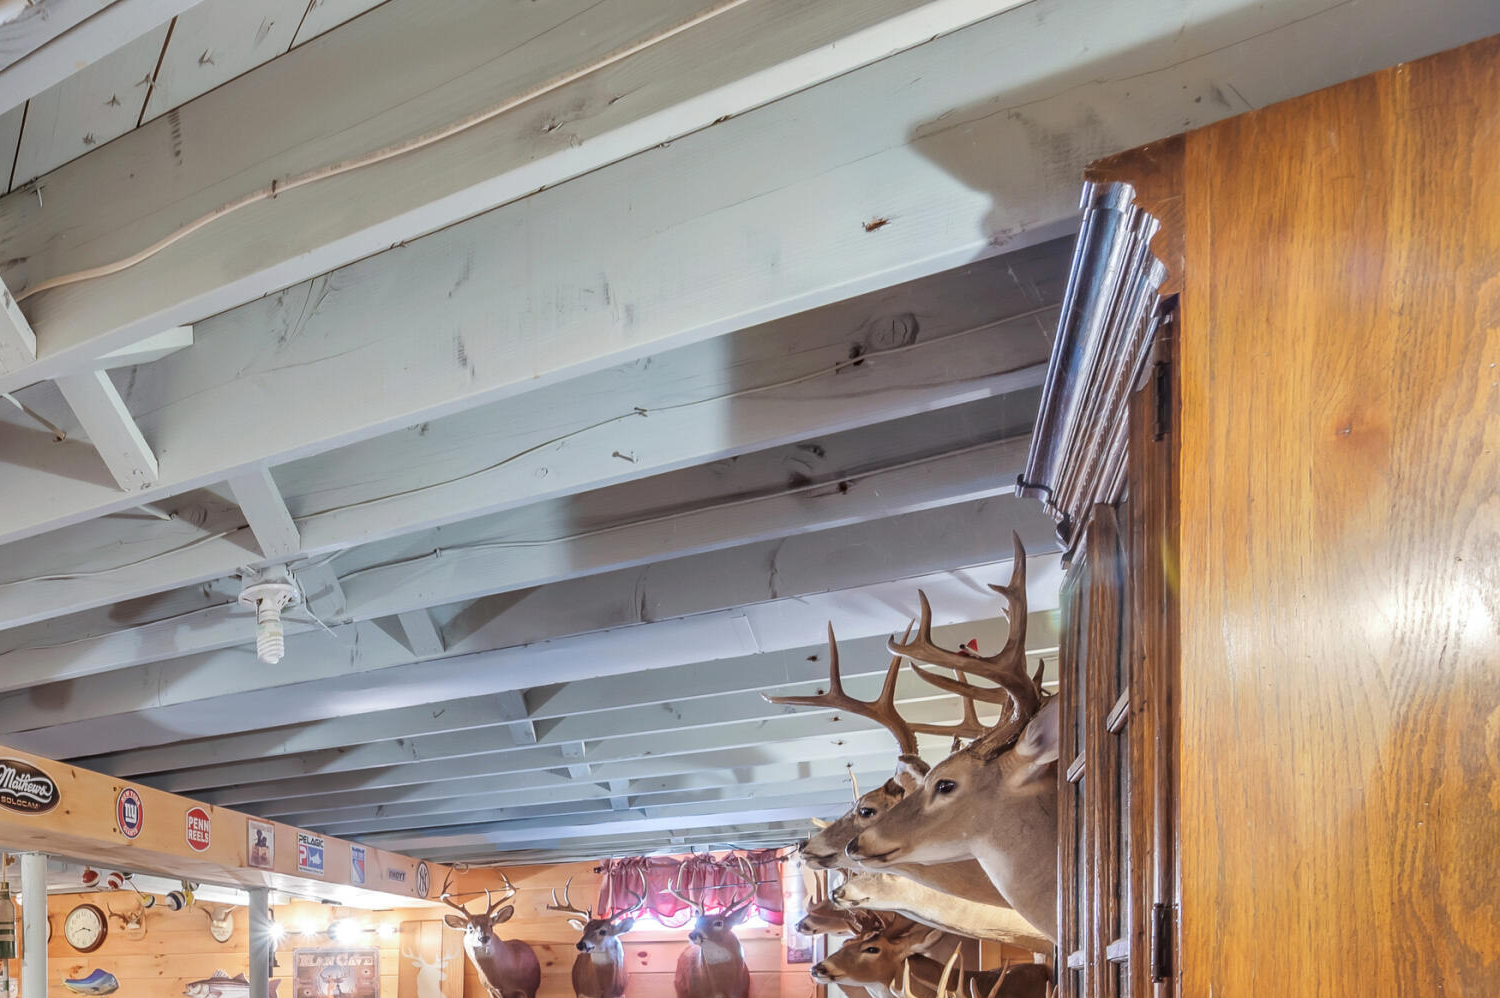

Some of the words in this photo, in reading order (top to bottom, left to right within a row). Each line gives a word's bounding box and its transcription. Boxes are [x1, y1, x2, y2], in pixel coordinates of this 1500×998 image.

[1, 796, 39, 809] SOLOCAM
[188, 816, 209, 832] PENN
[188, 830, 209, 843] REELS
[298, 834, 324, 848] PELAGIC
[299, 954, 335, 967] MAN
[336, 953, 374, 966] CAVE
